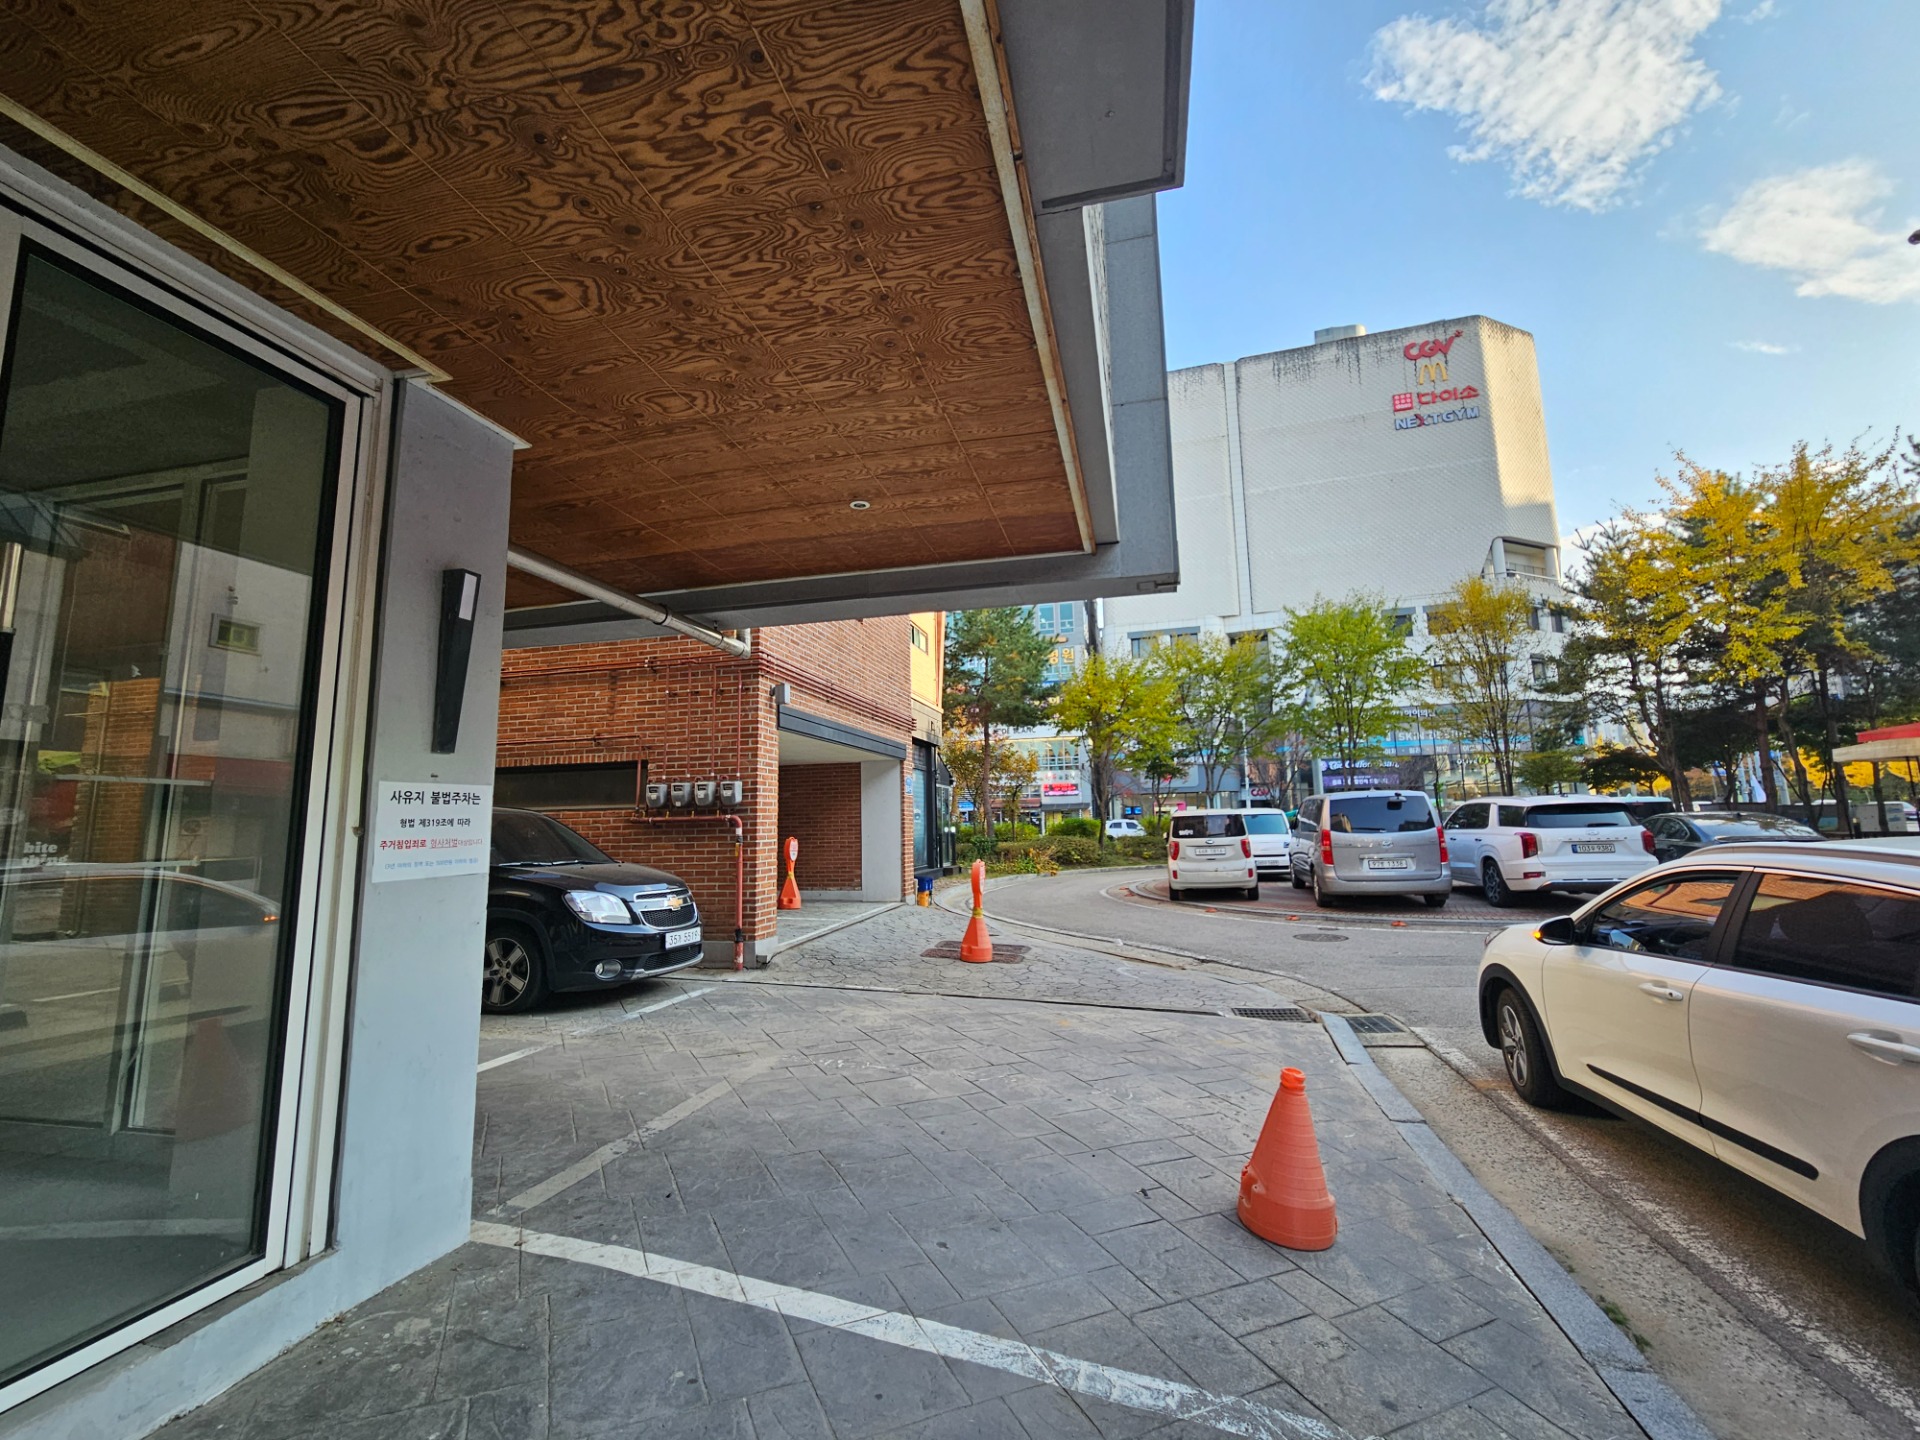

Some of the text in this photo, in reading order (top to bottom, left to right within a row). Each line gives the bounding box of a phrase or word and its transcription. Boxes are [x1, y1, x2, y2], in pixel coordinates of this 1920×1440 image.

[1403, 329, 1464, 361] CGV
[1417, 385, 1480, 405] 다이소
[390, 790, 481, 805] 사유지 불법주차는
[400, 818, 471, 828] 형법 제319조에 따라
[23, 842, 58, 853] bite
[379, 839, 427, 851] 주거침입죄로
